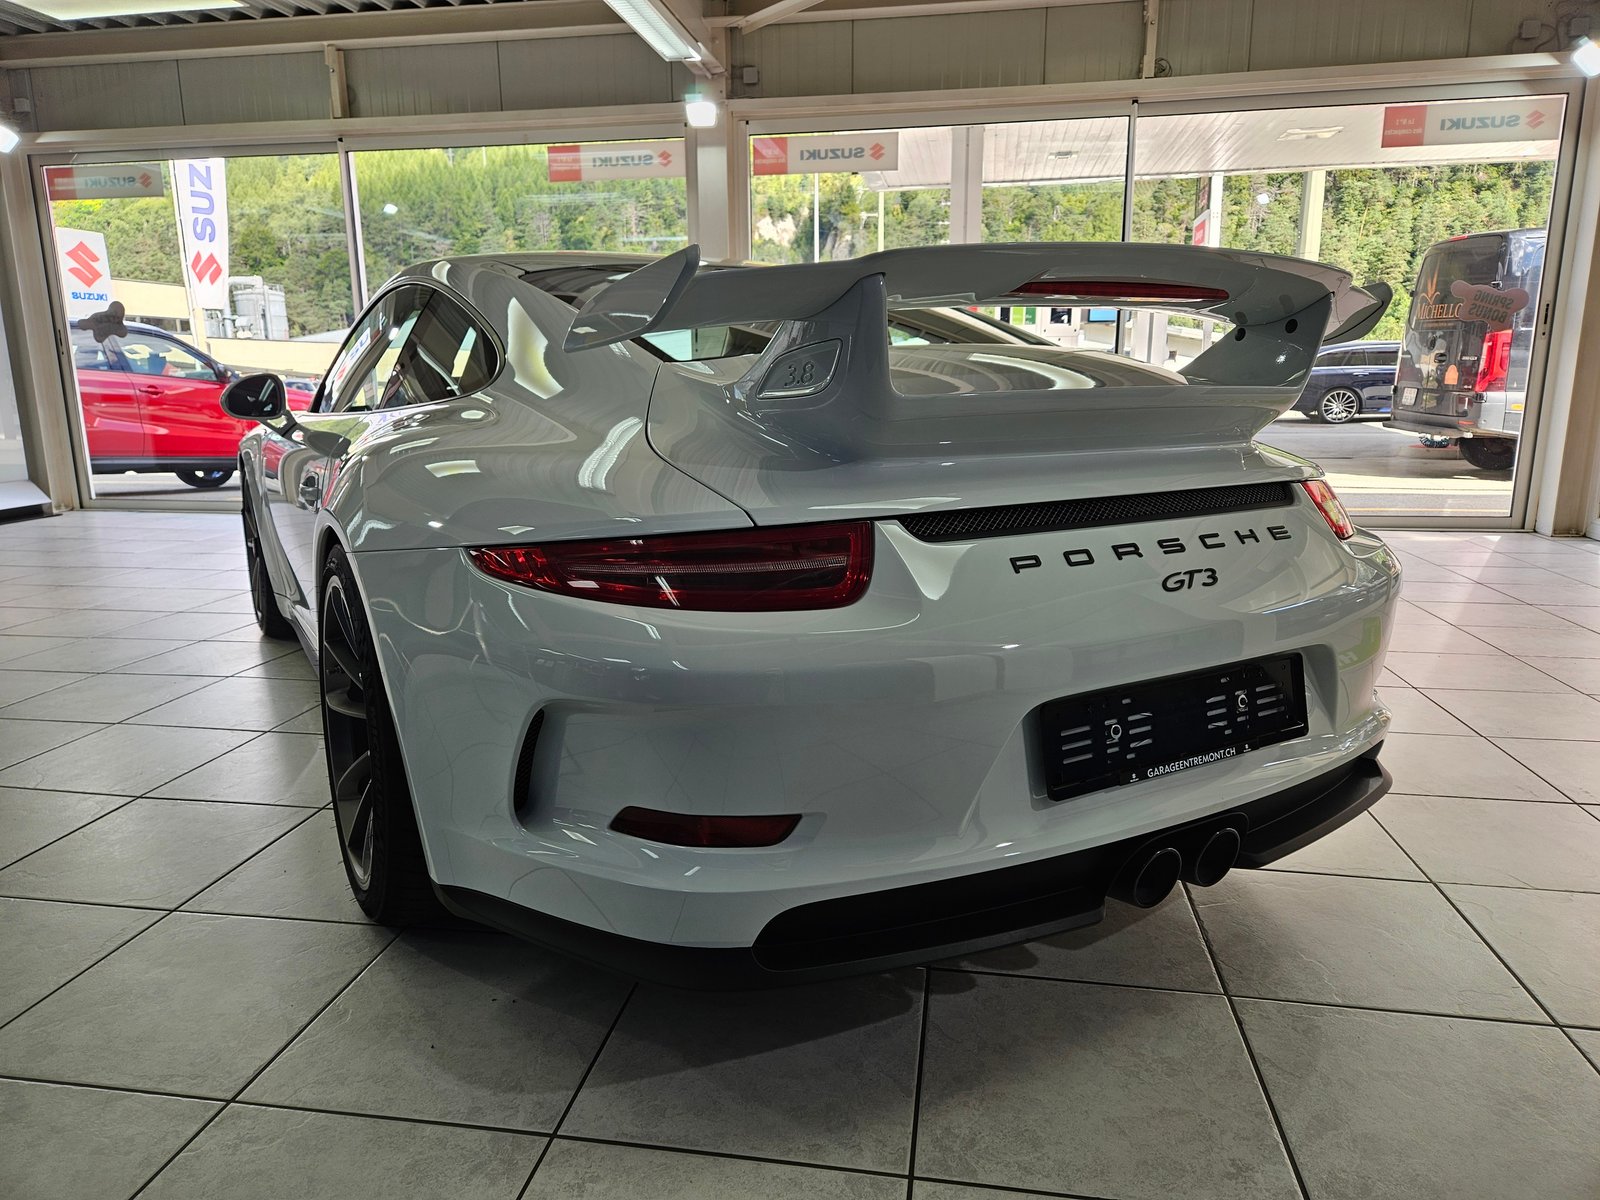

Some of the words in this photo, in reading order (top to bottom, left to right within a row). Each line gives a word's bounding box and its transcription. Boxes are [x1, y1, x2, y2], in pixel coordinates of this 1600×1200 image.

[188, 160, 216, 243] SUZ
[71, 291, 108, 302] SUZUKI
[784, 361, 815, 387] 3.8
[1009, 525, 1292, 574] PORSCHE
[1161, 567, 1219, 592] GT3
[1146, 747, 1236, 778] GARAGEENTREMONT.CH
